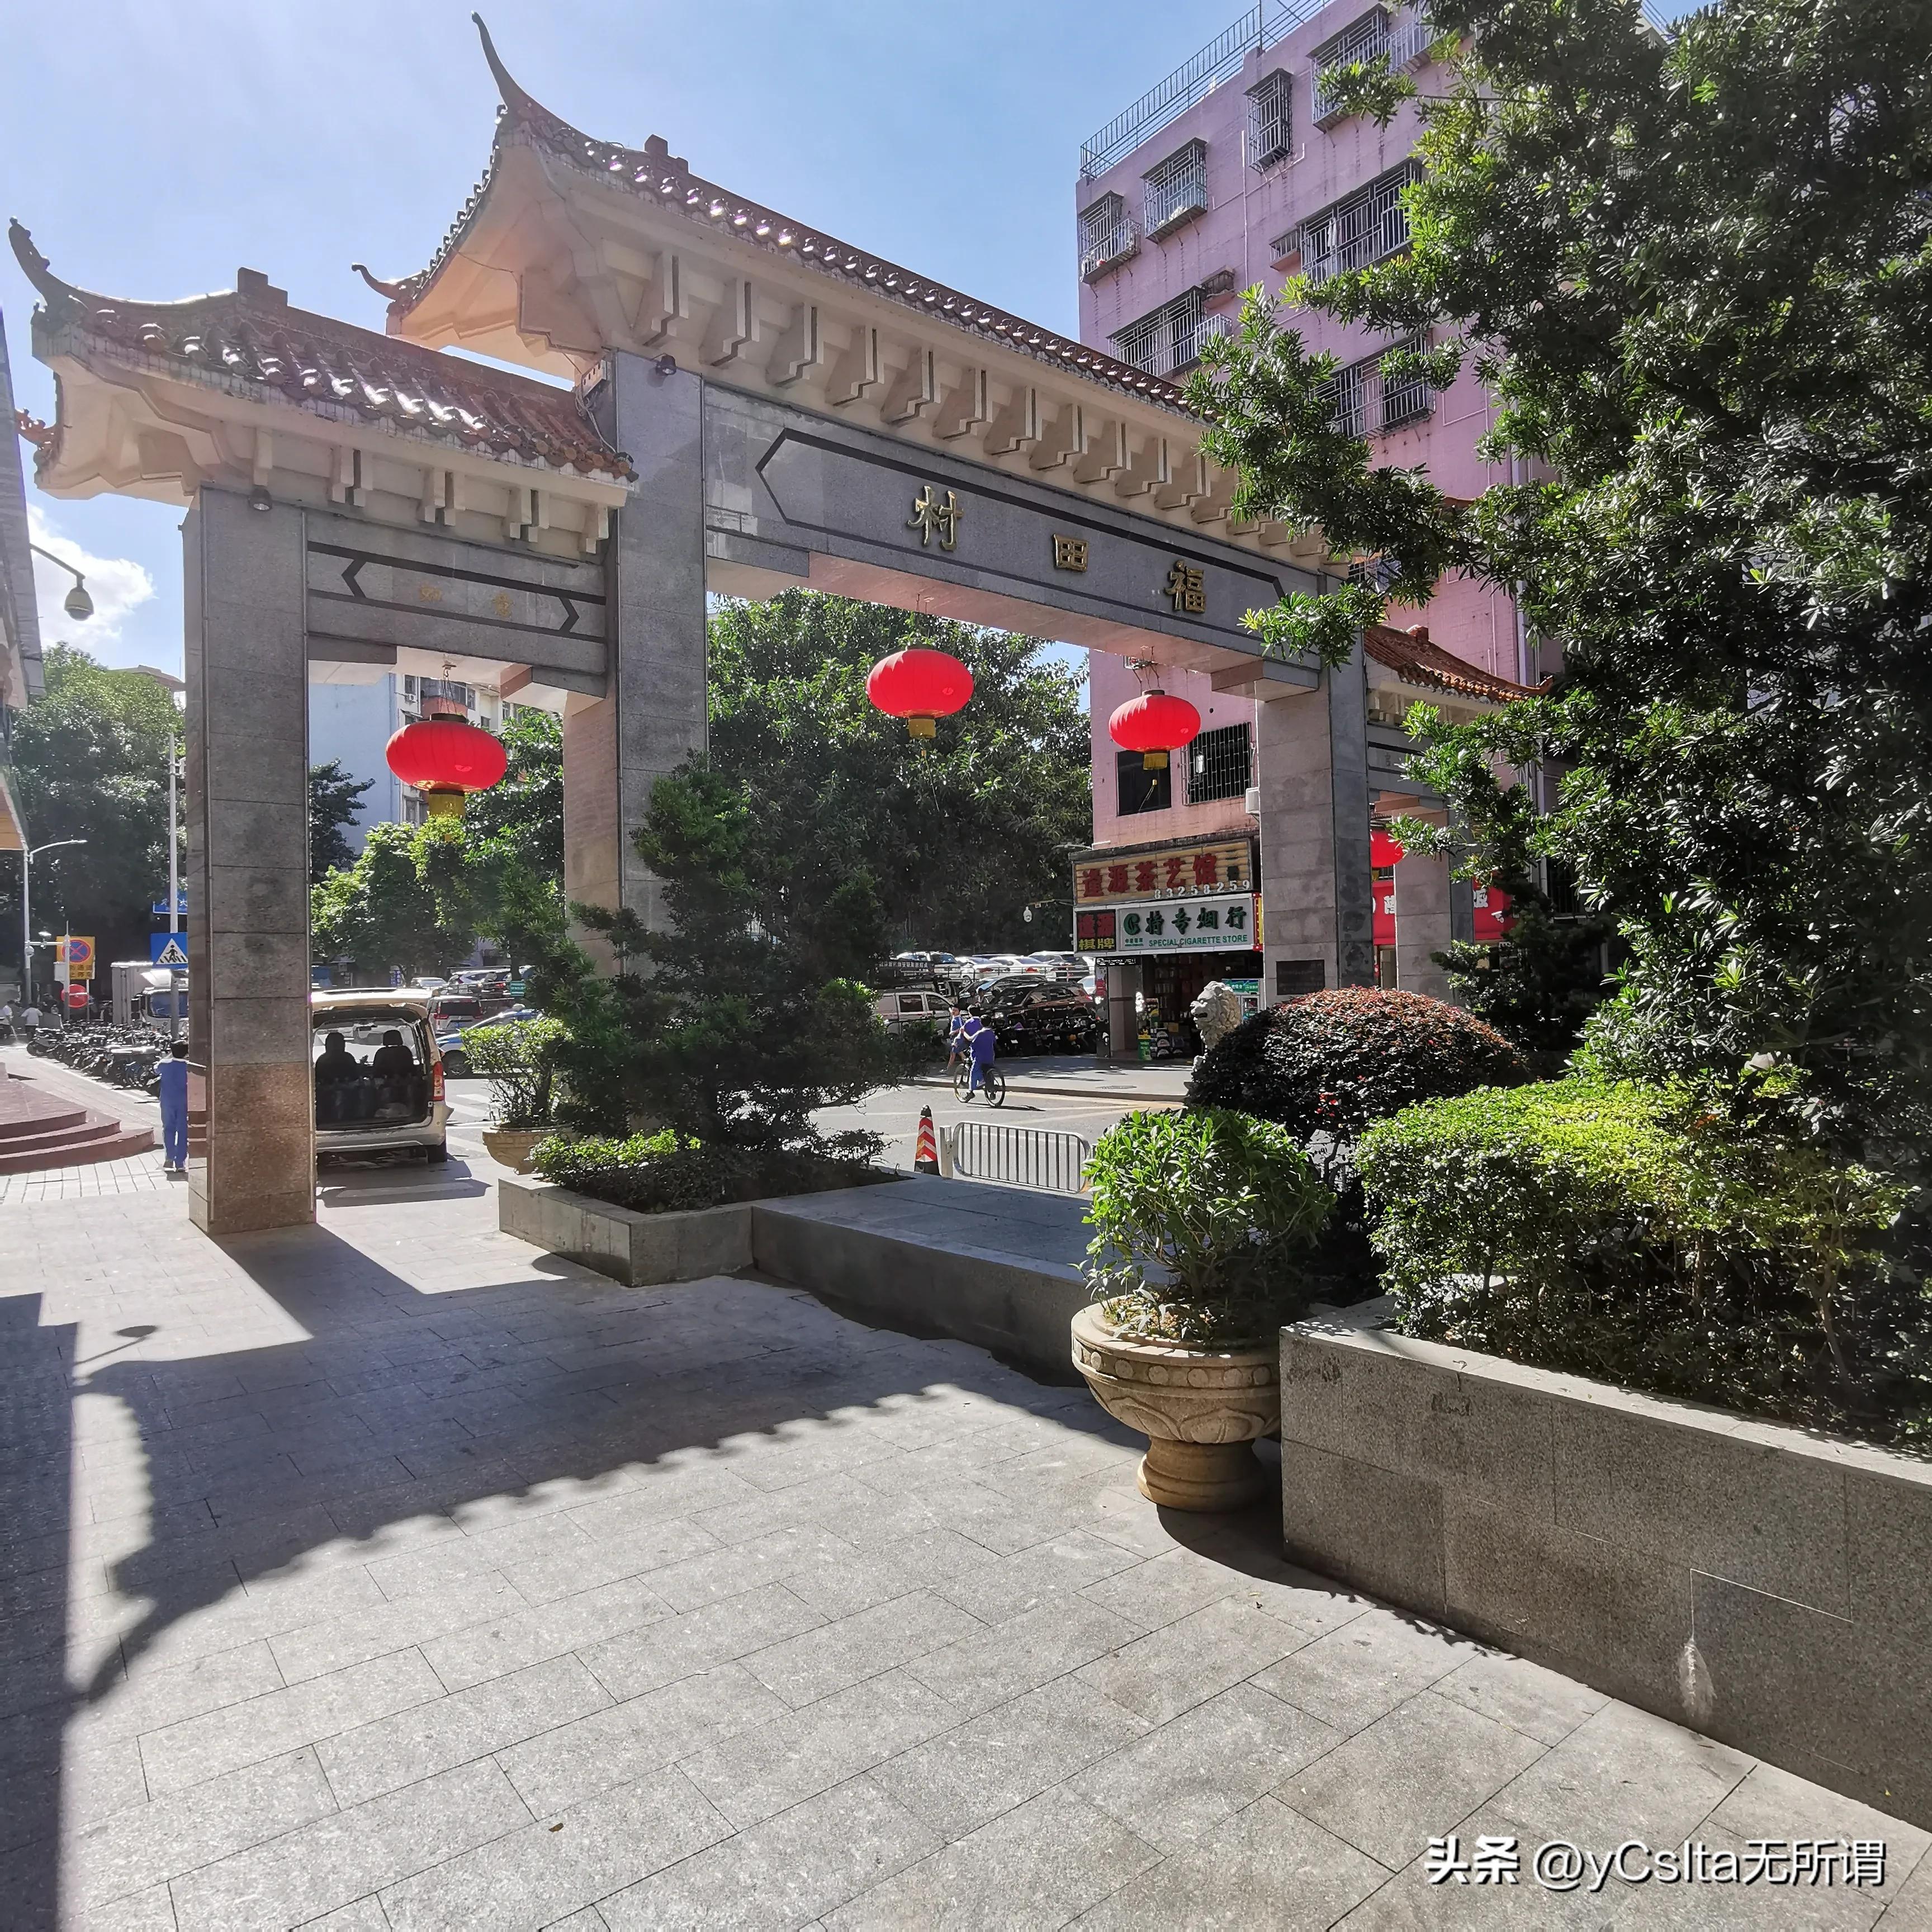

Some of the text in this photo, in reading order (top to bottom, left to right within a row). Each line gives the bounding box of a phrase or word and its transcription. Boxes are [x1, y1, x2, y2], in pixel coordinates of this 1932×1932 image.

[1078, 937, 1115, 950] 棋牌
[1149, 939, 1178, 947] SPECIAL
[1180, 936, 1221, 945] CIGARETTE
[1222, 934, 1248, 943] STORE
